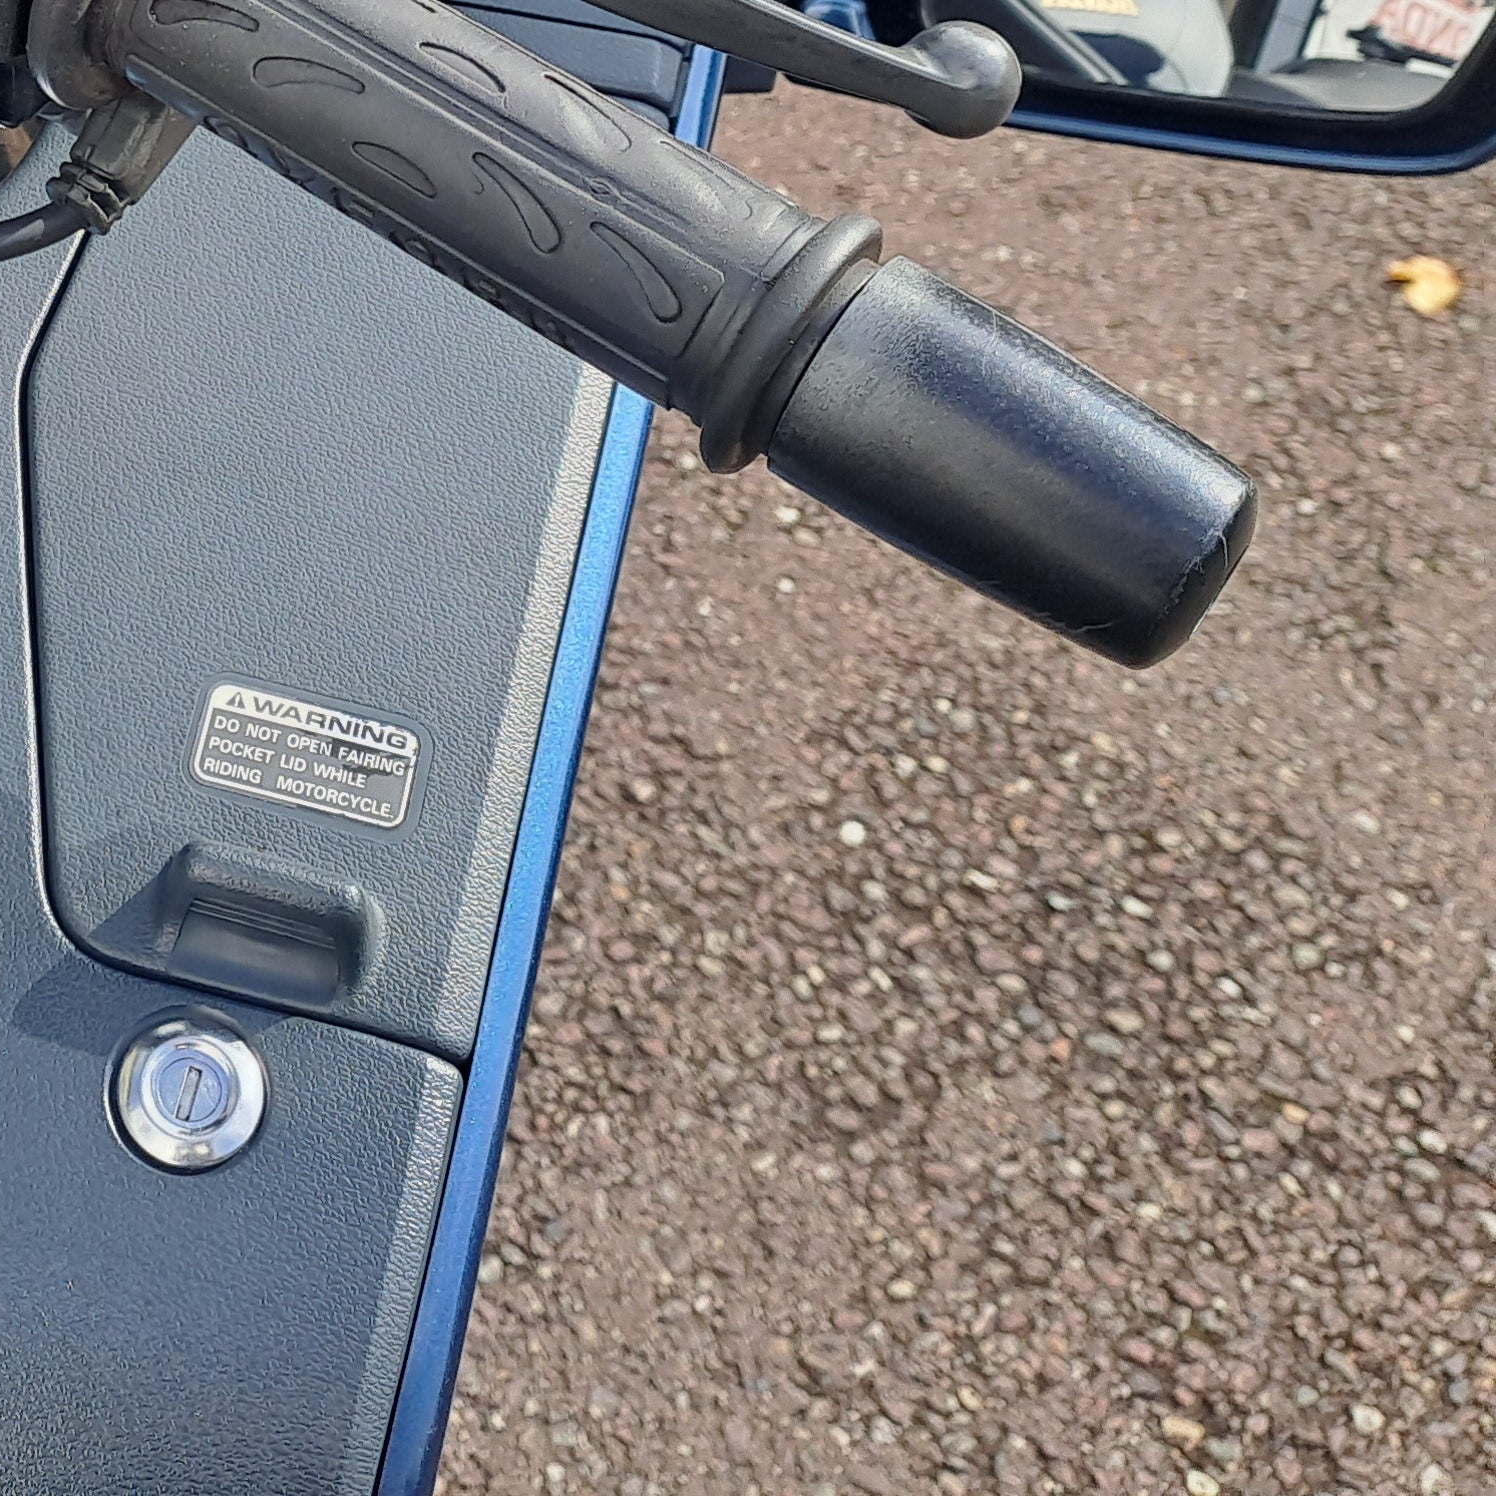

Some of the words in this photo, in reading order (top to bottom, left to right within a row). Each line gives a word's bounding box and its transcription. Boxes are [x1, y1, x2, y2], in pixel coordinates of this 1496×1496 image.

[214, 715, 241, 733] DO
[246, 723, 282, 744] NOT
[287, 733, 333, 757] OPEN
[338, 746, 406, 776] FAIRING
[252, 696, 408, 750] WARNING
[204, 757, 262, 784] RIDING
[208, 736, 275, 764] POCKET
[280, 753, 307, 773] LID
[314, 762, 367, 789] WHILE
